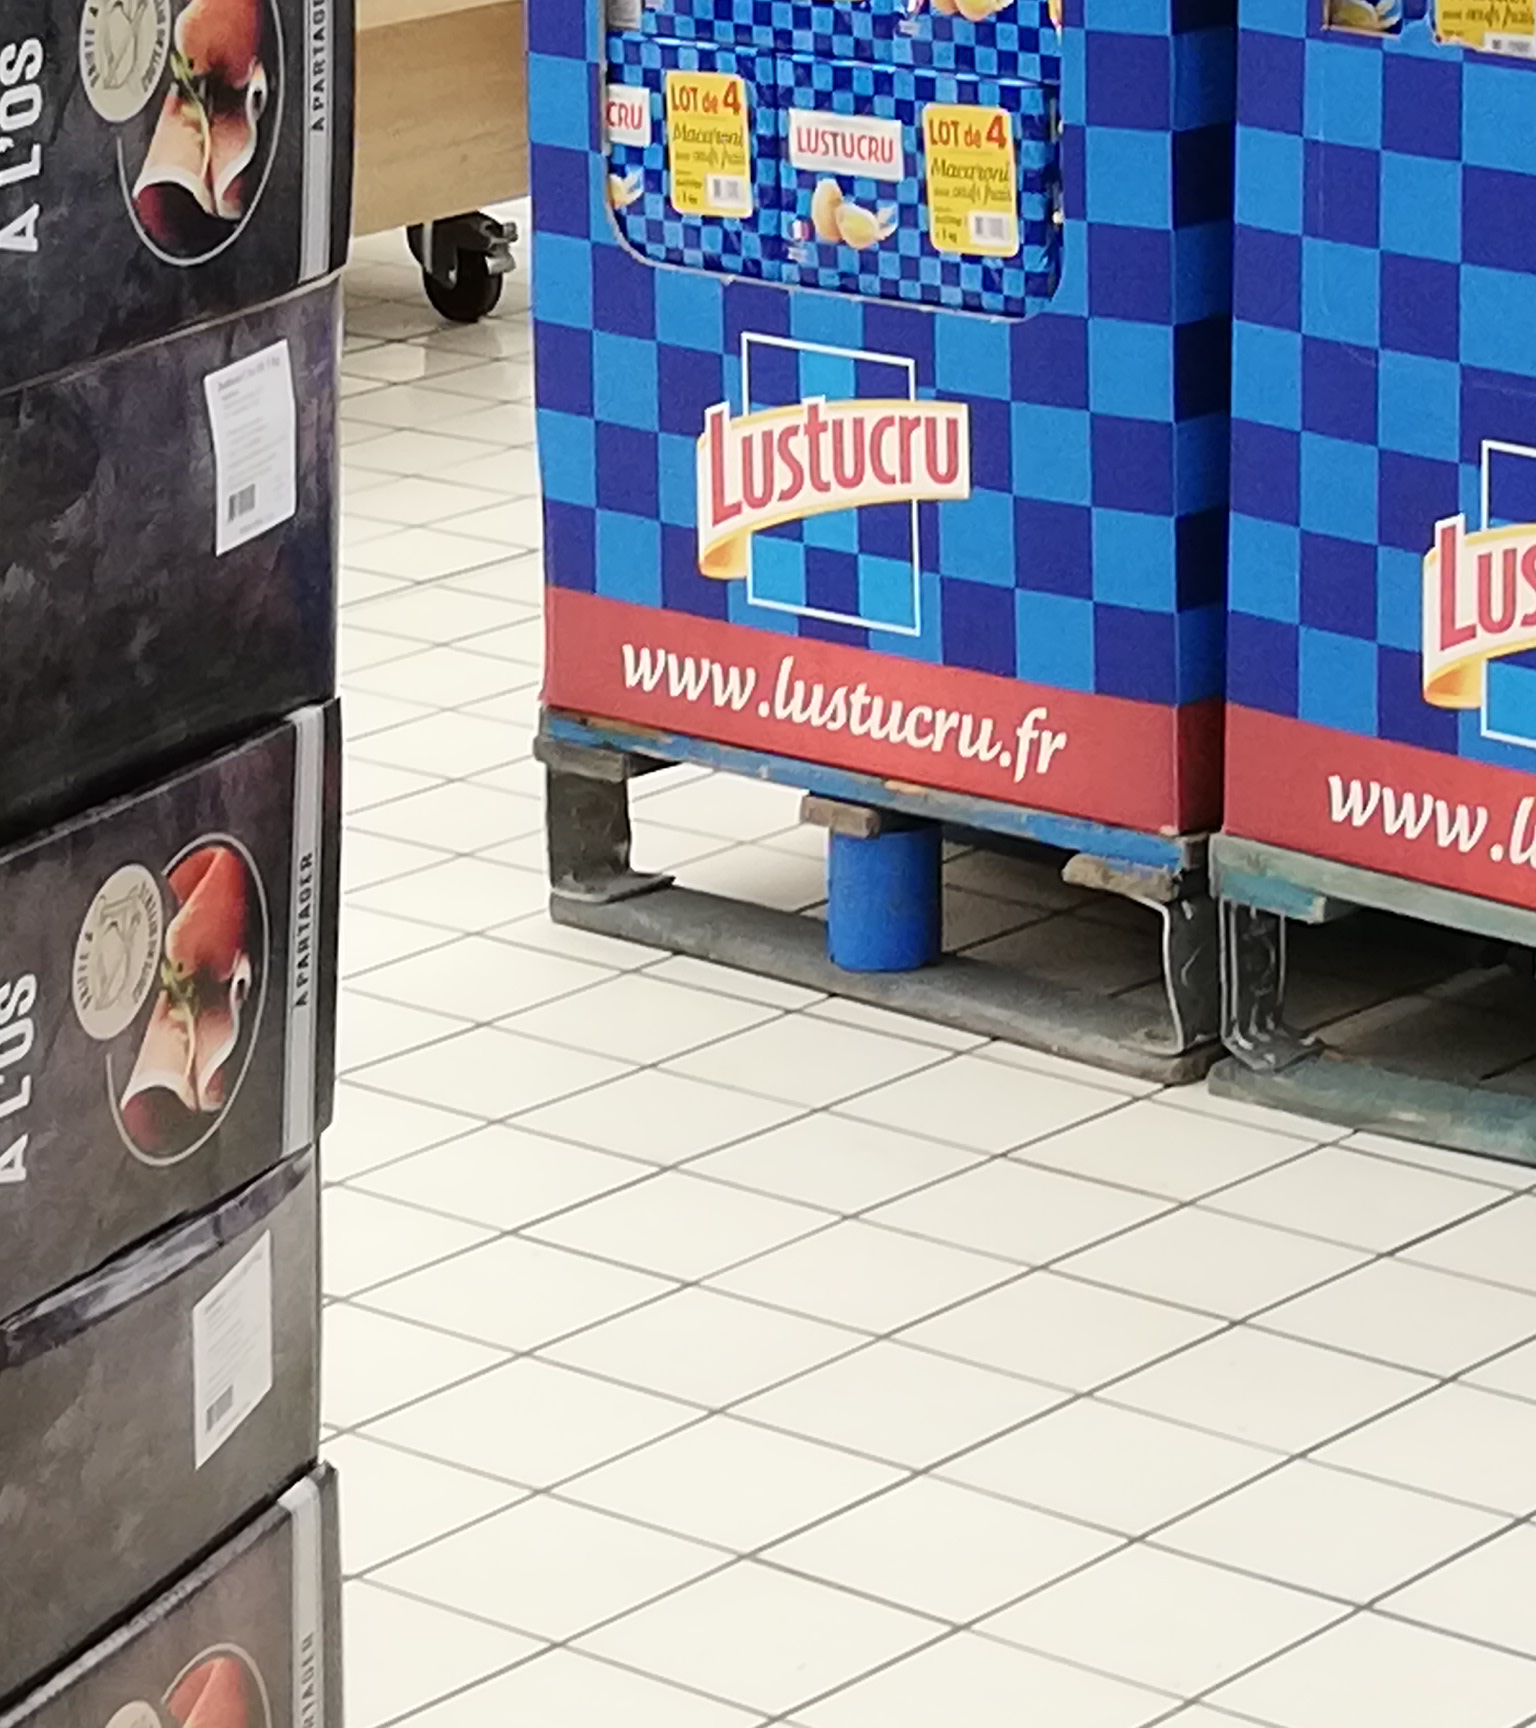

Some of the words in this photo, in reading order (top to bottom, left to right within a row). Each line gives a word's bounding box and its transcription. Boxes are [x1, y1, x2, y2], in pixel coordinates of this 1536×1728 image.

[671, 86, 699, 114] LOT
[702, 90, 720, 114] de
[722, 80, 742, 115] 4
[671, 123, 744, 149] Macaroni
[796, 126, 895, 164] LUSTUCRU
[929, 117, 961, 148] LOT
[963, 120, 982, 149] de
[985, 115, 1007, 149] 4
[930, 156, 1010, 184] Macaroni
[709, 402, 959, 528] Lustucru
[621, 642, 1067, 783] www.lustucru.fr
